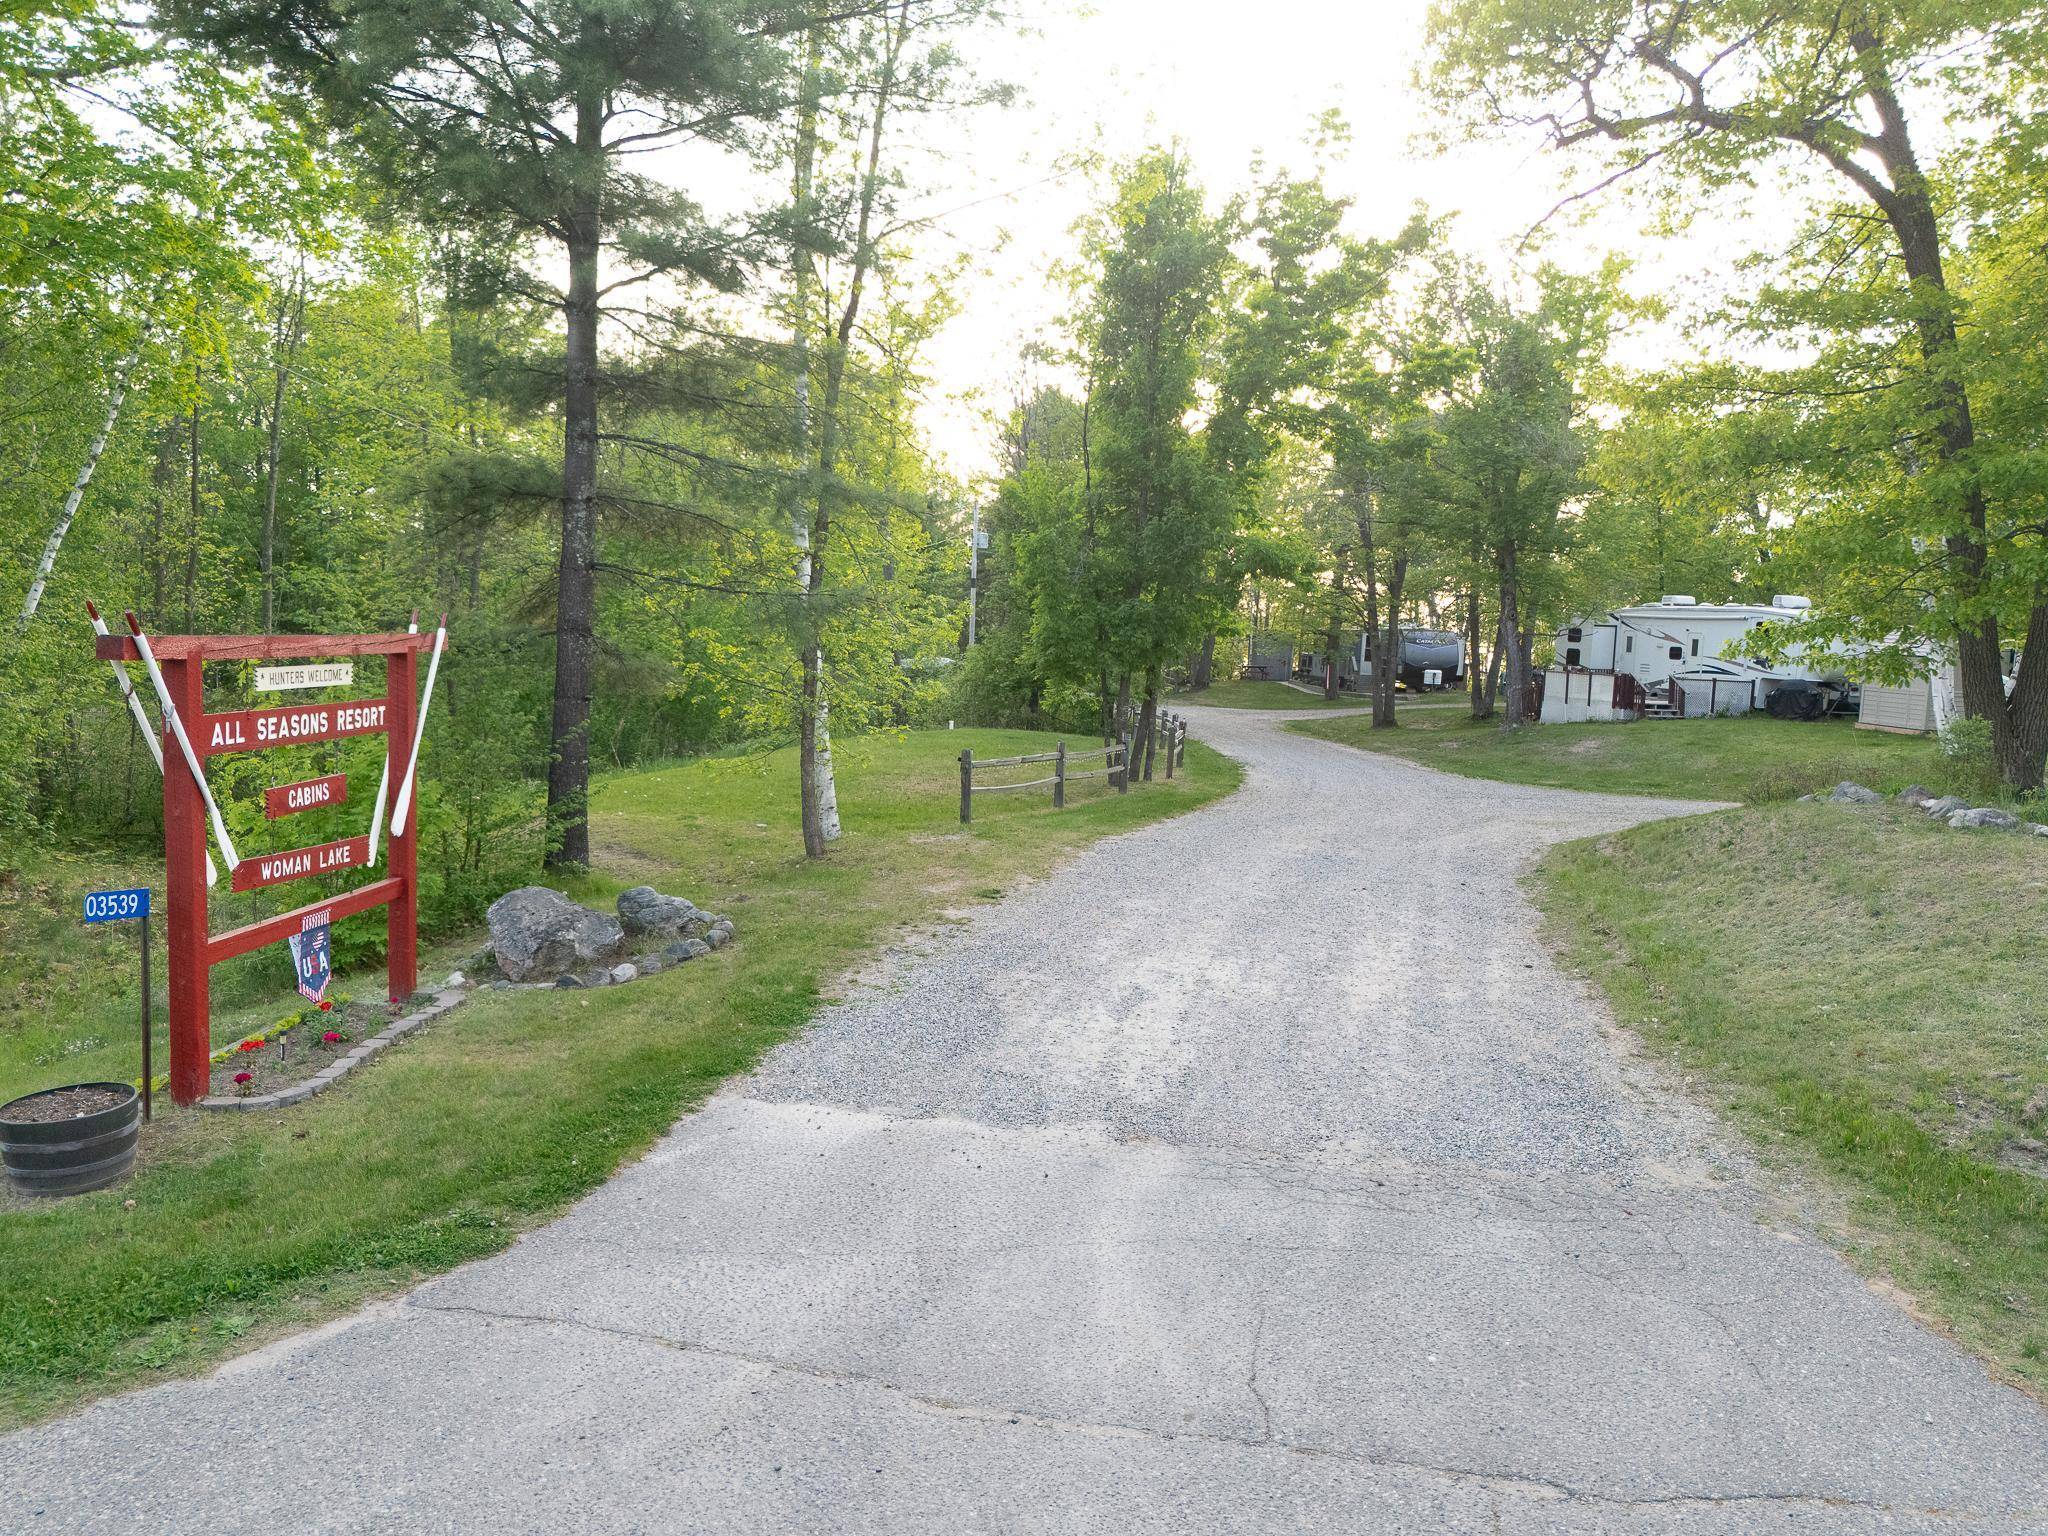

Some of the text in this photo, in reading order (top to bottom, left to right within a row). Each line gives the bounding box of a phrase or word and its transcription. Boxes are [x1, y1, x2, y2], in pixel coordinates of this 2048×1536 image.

[269, 668, 343, 685] HUNTERS WELCOME
[211, 705, 386, 746] ALL SEASONS RESORT
[288, 782, 330, 808] CABINS
[261, 845, 351, 880] WOMAN LAKE
[86, 894, 138, 917] 03539
[302, 951, 328, 978] USA
